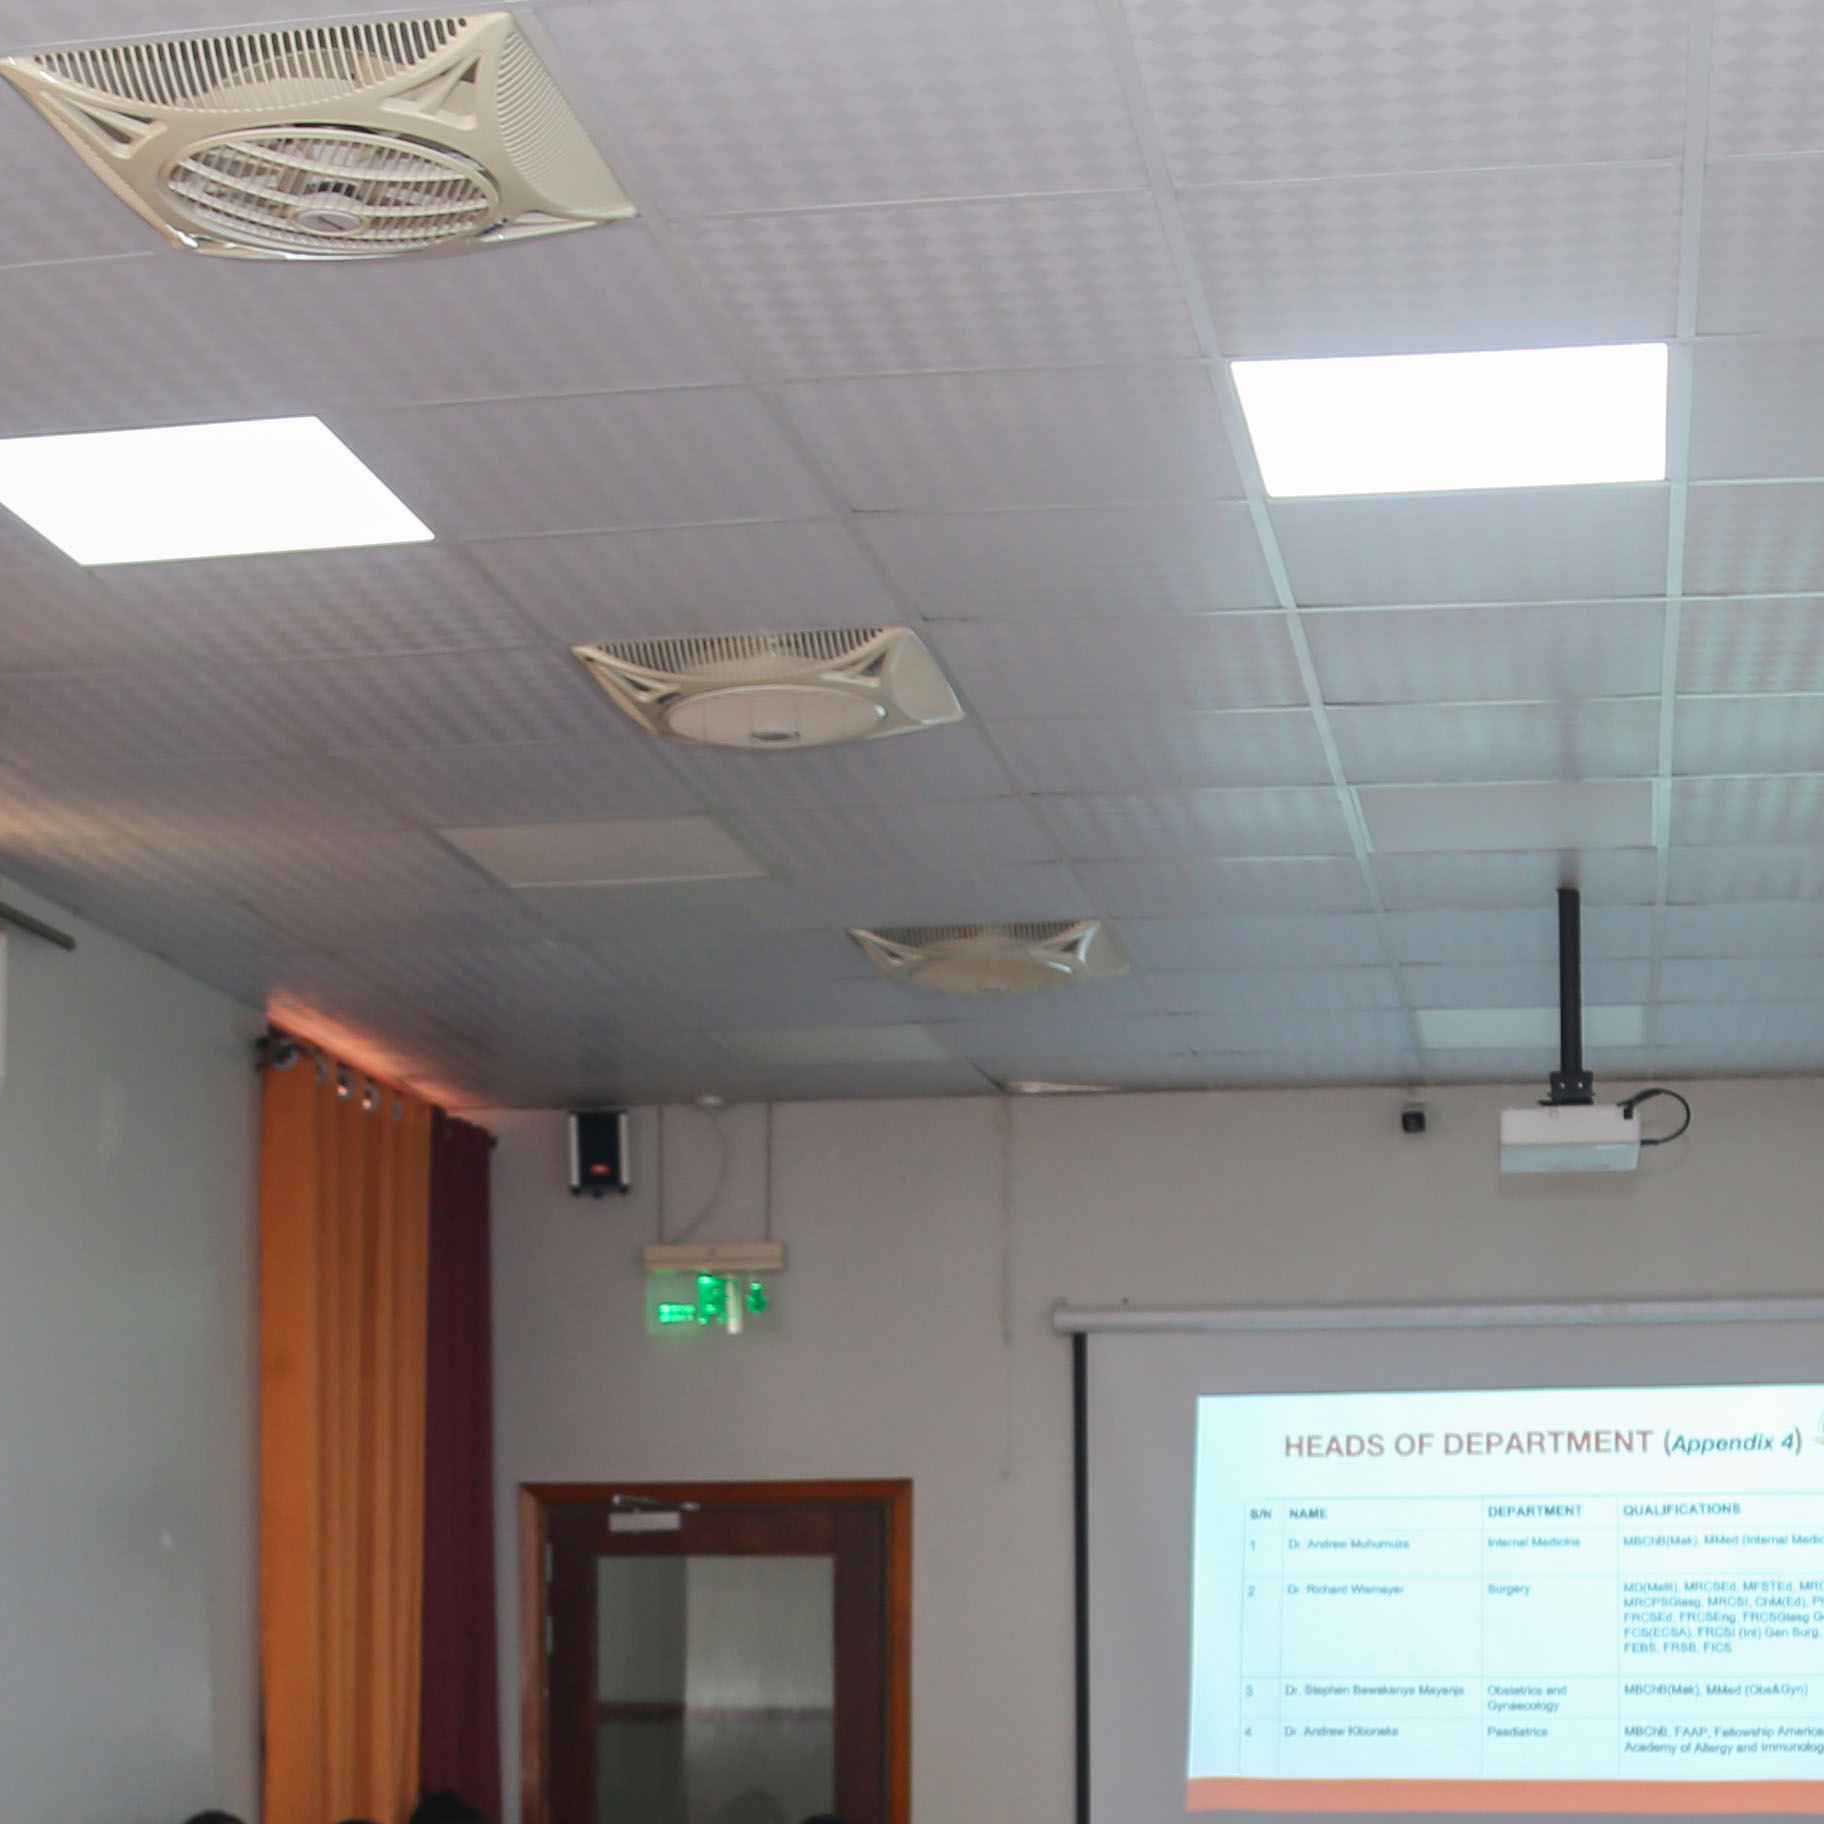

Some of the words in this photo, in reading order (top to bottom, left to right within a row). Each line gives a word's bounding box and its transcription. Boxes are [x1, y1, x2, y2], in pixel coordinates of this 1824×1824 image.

[1284, 1434, 1385, 1458] HEADS
[1395, 1432, 1434, 1457] OF
[1444, 1428, 1653, 1456] DEPARTMENT
[1664, 1428, 1773, 1457] (Appendix
[1781, 1427, 1802, 1456] 4)
[1250, 1507, 1273, 1520] S/N
[1289, 1507, 1328, 1520] NAME
[1487, 1503, 1583, 1519] DEPARTMENT
[1623, 1502, 1741, 1516] QUALIFICATIONS
[1307, 1537, 1348, 1550] Andrew
[1487, 1536, 1529, 1548] Internal
[1532, 1536, 1581, 1548] Medicine
[1742, 1532, 1788, 1548] (Internal
[1248, 1584, 1256, 1597] 2
[1307, 1582, 1348, 1595] Richard
[1487, 1582, 1531, 1598] Surgery
[1764, 1626, 1789, 1640] Gen
[1246, 1685, 1254, 1697] 3
[1305, 1684, 1350, 1698] Stephen
[1487, 1684, 1544, 1697] Obstetrics
[1547, 1684, 1567, 1696] and
[1487, 1700, 1561, 1715] Gynaecology
[1304, 1725, 1345, 1737] Andrew
[1487, 1725, 1549, 1738] Paediatrics
[1714, 1725, 1774, 1739] Fellowship
[1624, 1742, 1676, 1756] Academy
[1680, 1741, 1692, 1754] of
[1694, 1741, 1733, 1757] Allergy
[1736, 1741, 1758, 1754] and
